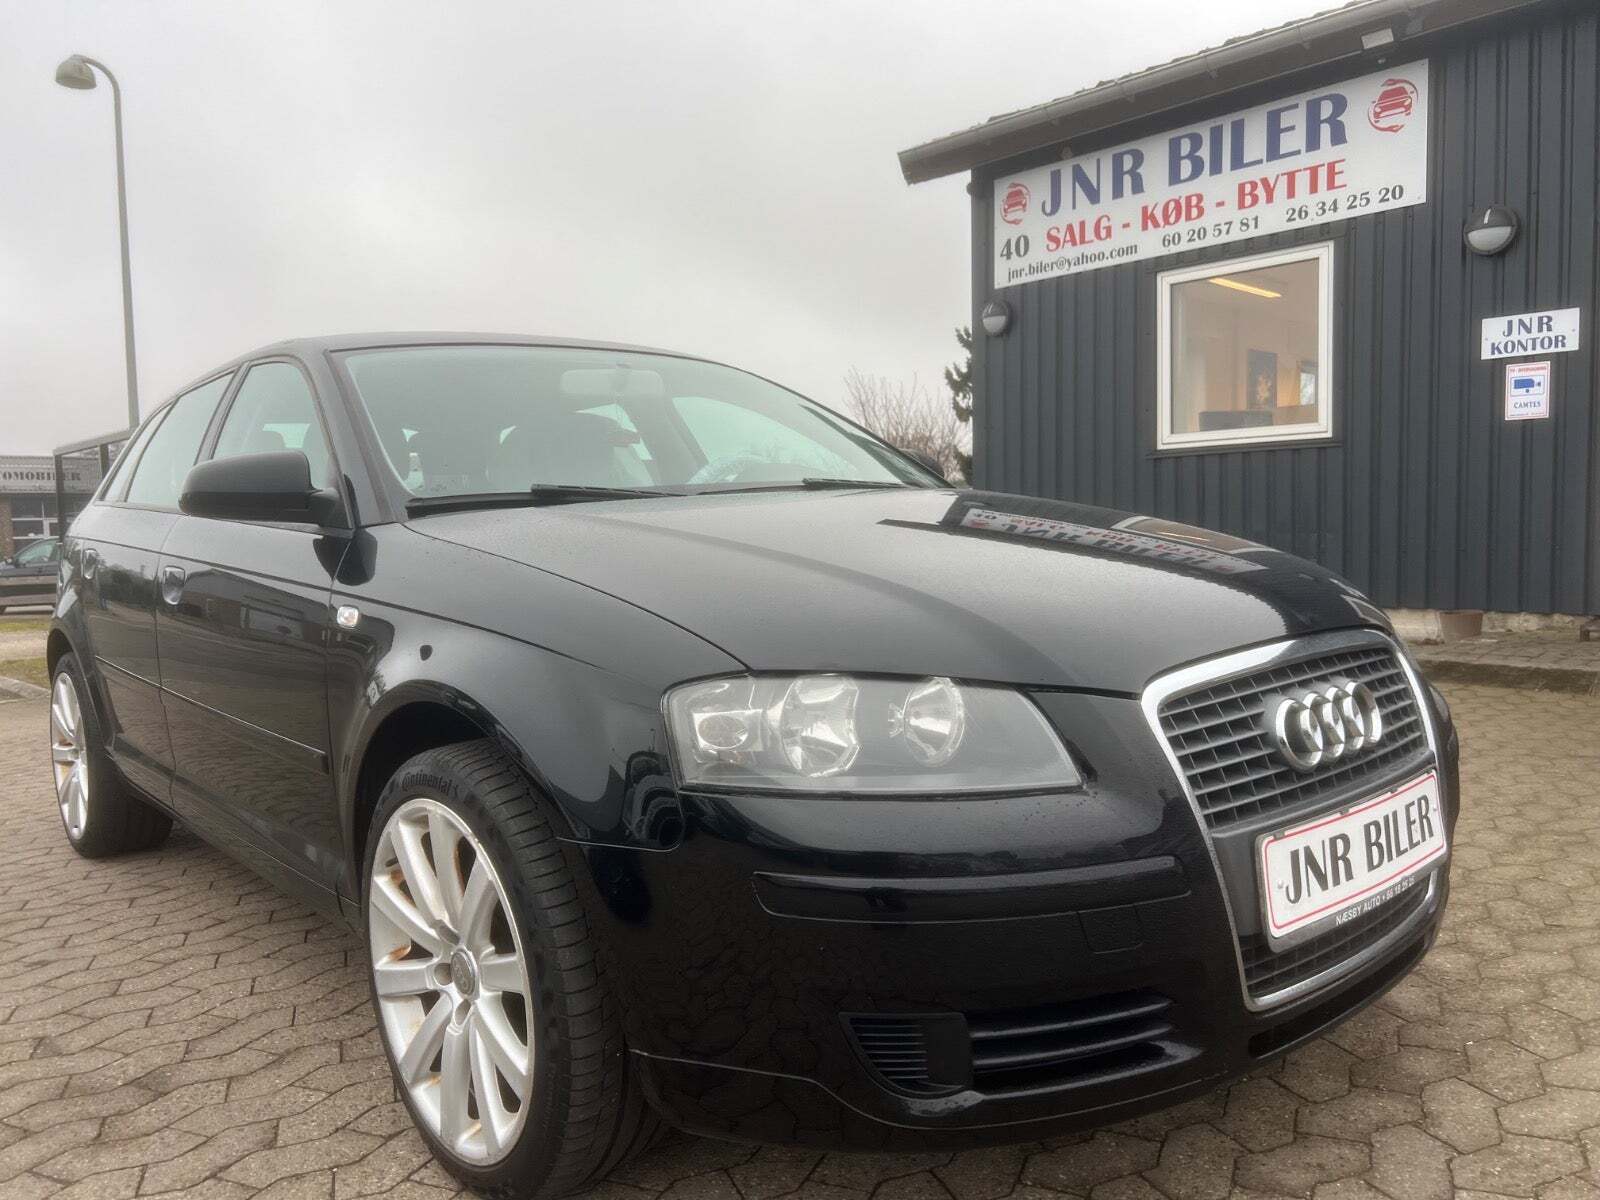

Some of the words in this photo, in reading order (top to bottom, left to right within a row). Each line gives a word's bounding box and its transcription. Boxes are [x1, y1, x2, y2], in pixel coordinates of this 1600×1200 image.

[1041, 148, 1145, 217] JNR
[1168, 93, 1348, 187] BILER
[1046, 214, 1112, 252] SALG
[1141, 192, 1205, 231] KØB
[1237, 158, 1347, 211] BYTTE
[1286, 206, 1309, 223] 26
[1315, 199, 1338, 217] 34
[1346, 191, 1371, 211] 25
[1378, 184, 1404, 204] 20
[1000, 234, 1030, 261] 40
[1162, 232, 1182, 248] 60
[1187, 227, 1207, 243] 20
[1212, 221, 1233, 237] 57
[1239, 215, 1259, 232] 81
[1008, 244, 1138, 283] jnr.biler@yahoo.com
[1502, 315, 1553, 338] JNR
[1490, 334, 1567, 356] KONTOR
[401, 769, 453, 796] Continental
[1285, 832, 1354, 905] JNR
[1363, 794, 1434, 873] BILER
[1335, 905, 1362, 926] NÆSBY
[1363, 895, 1381, 913] AUTO
